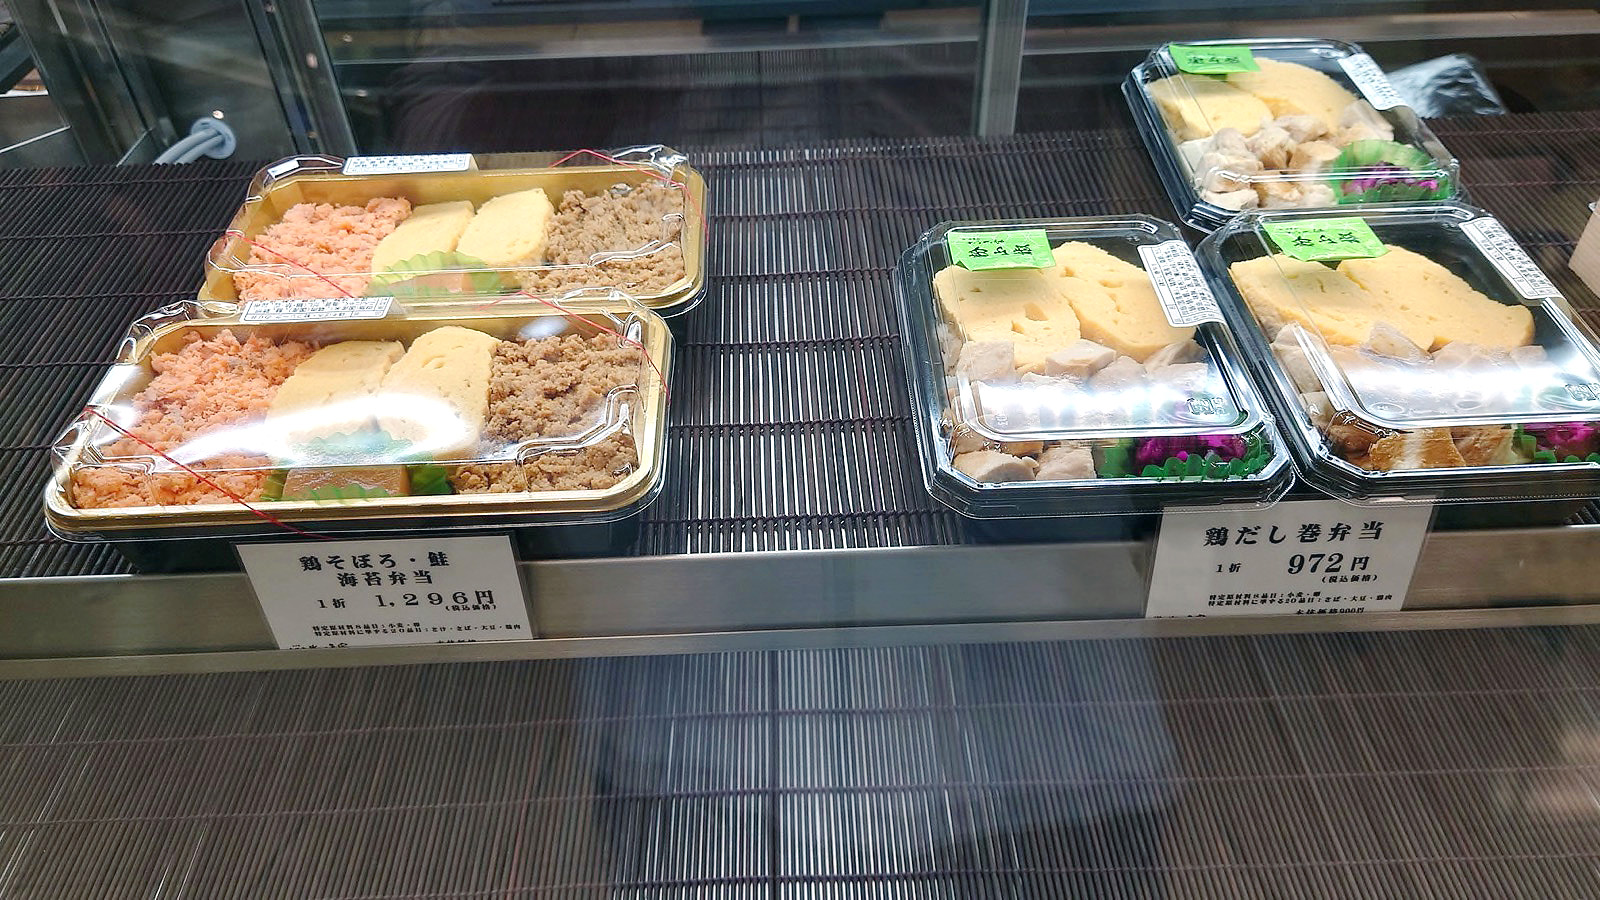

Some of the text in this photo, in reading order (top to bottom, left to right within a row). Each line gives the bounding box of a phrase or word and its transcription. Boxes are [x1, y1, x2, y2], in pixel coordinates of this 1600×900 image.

[1203, 520, 1384, 547] 鶏だし巻弁当
[299, 551, 450, 572] 鶏そぼろ・鮭
[1216, 562, 1242, 573] 1折
[337, 569, 433, 588] 海苔弁当
[316, 597, 346, 609] 1折
[375, 589, 495, 608] 1,296円
